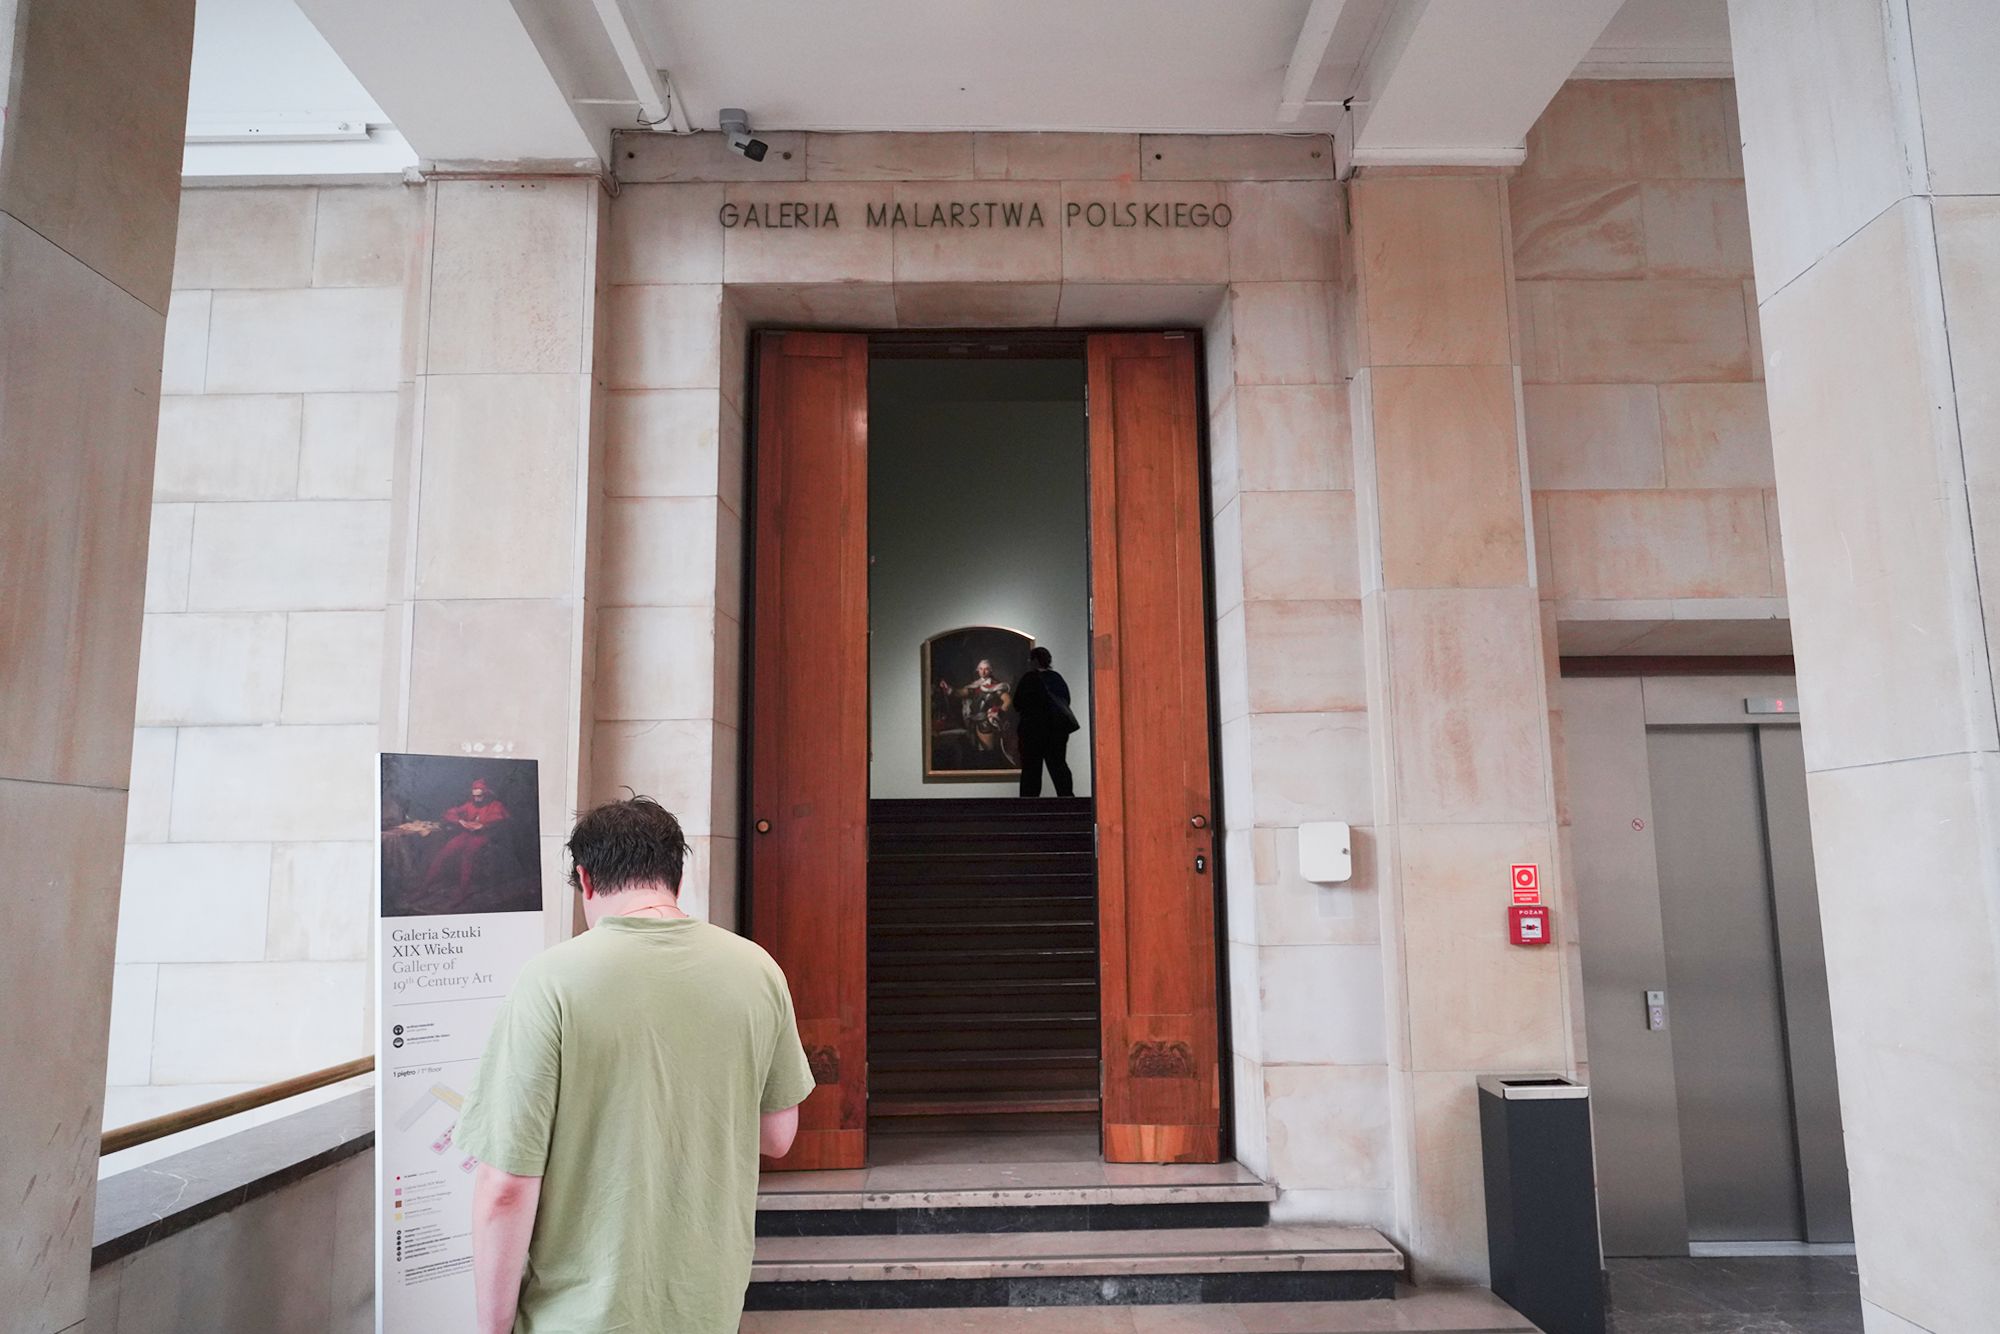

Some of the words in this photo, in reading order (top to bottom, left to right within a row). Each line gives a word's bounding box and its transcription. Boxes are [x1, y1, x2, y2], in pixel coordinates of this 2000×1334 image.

[719, 202, 840, 228] GALERIA
[866, 202, 1045, 228] MALARSTWA
[1066, 202, 1233, 228] POLSKIEGO
[392, 928, 439, 942] Galeria
[442, 926, 481, 939] Sztuki
[392, 944, 421, 958] XIX
[424, 943, 464, 956] Wieku
[392, 960, 440, 976] Gallery
[443, 958, 457, 970] of
[417, 975, 469, 989] Century
[472, 972, 493, 984] Art
